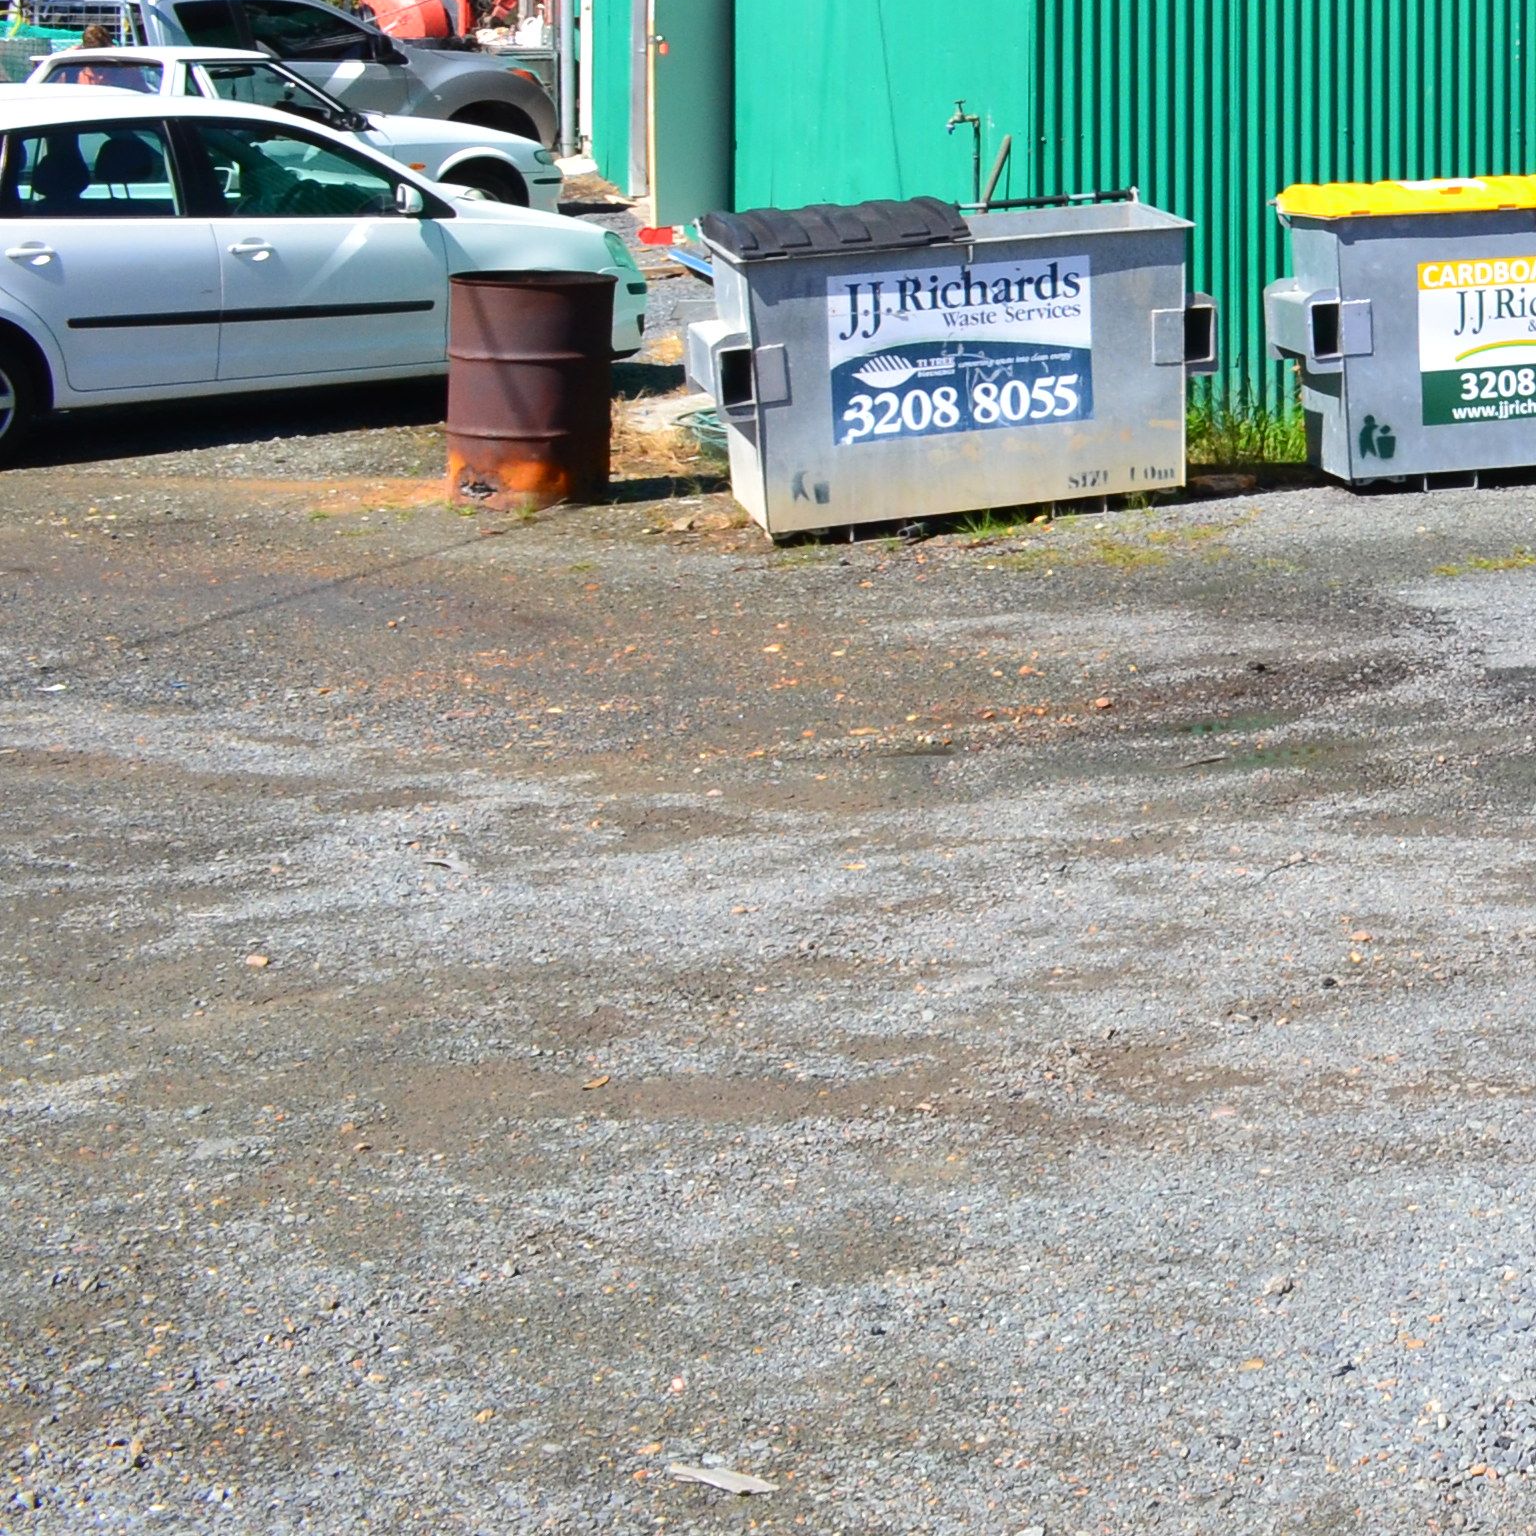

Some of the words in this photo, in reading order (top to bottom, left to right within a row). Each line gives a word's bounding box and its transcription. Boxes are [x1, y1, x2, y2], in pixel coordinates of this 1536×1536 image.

[897, 261, 1080, 312] Richards
[942, 309, 997, 328] Waste
[1005, 303, 1081, 323] Services
[1460, 367, 1536, 401] 3208
[843, 386, 960, 438] 3208
[972, 373, 1079, 424] 8055
